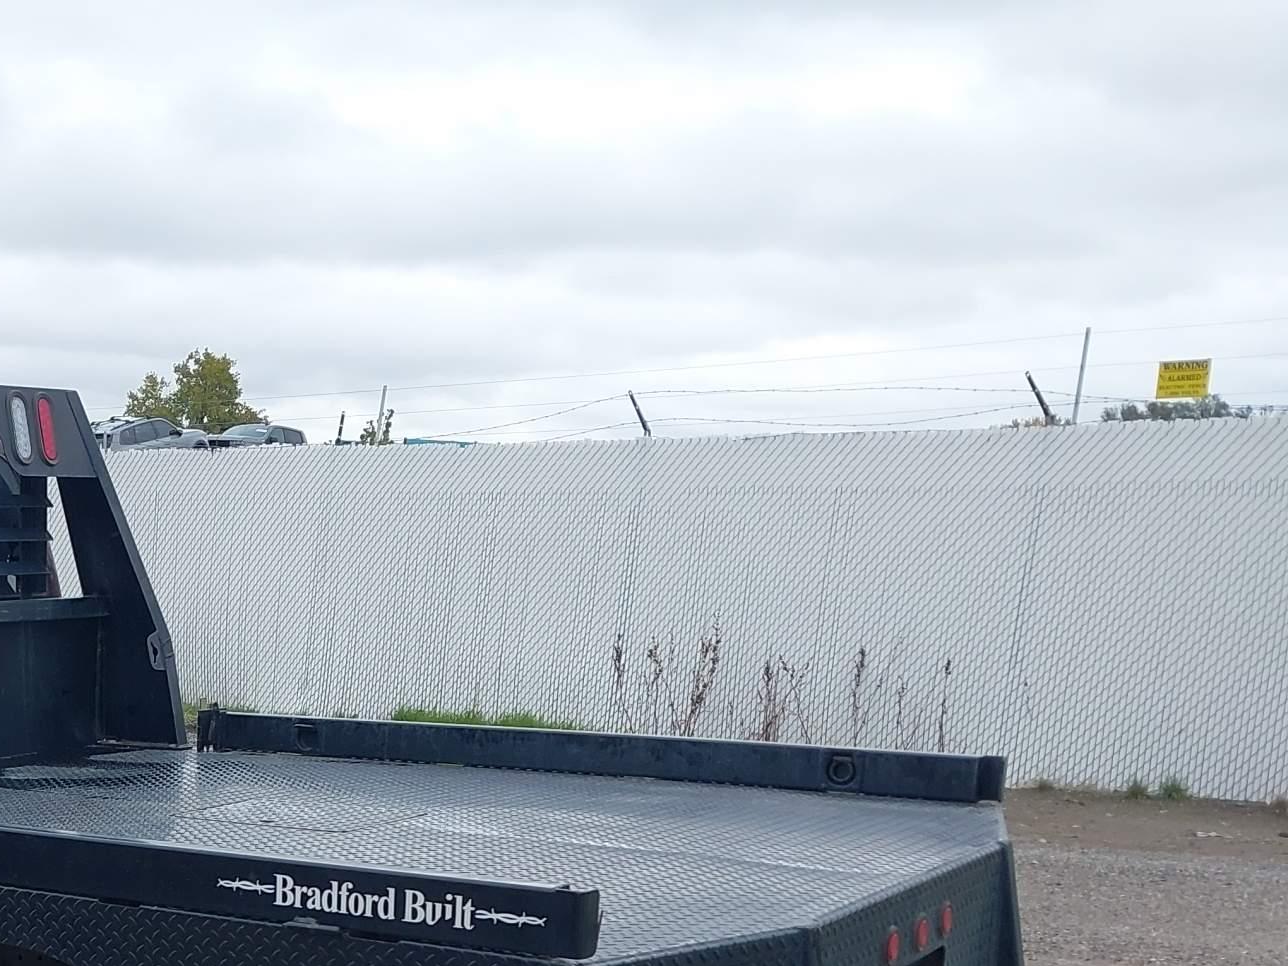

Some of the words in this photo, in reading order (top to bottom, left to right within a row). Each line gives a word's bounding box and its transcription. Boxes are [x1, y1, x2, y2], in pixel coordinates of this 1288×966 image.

[1163, 360, 1208, 370] WARNING
[273, 873, 396, 921] Bradford
[402, 889, 476, 930] Built
